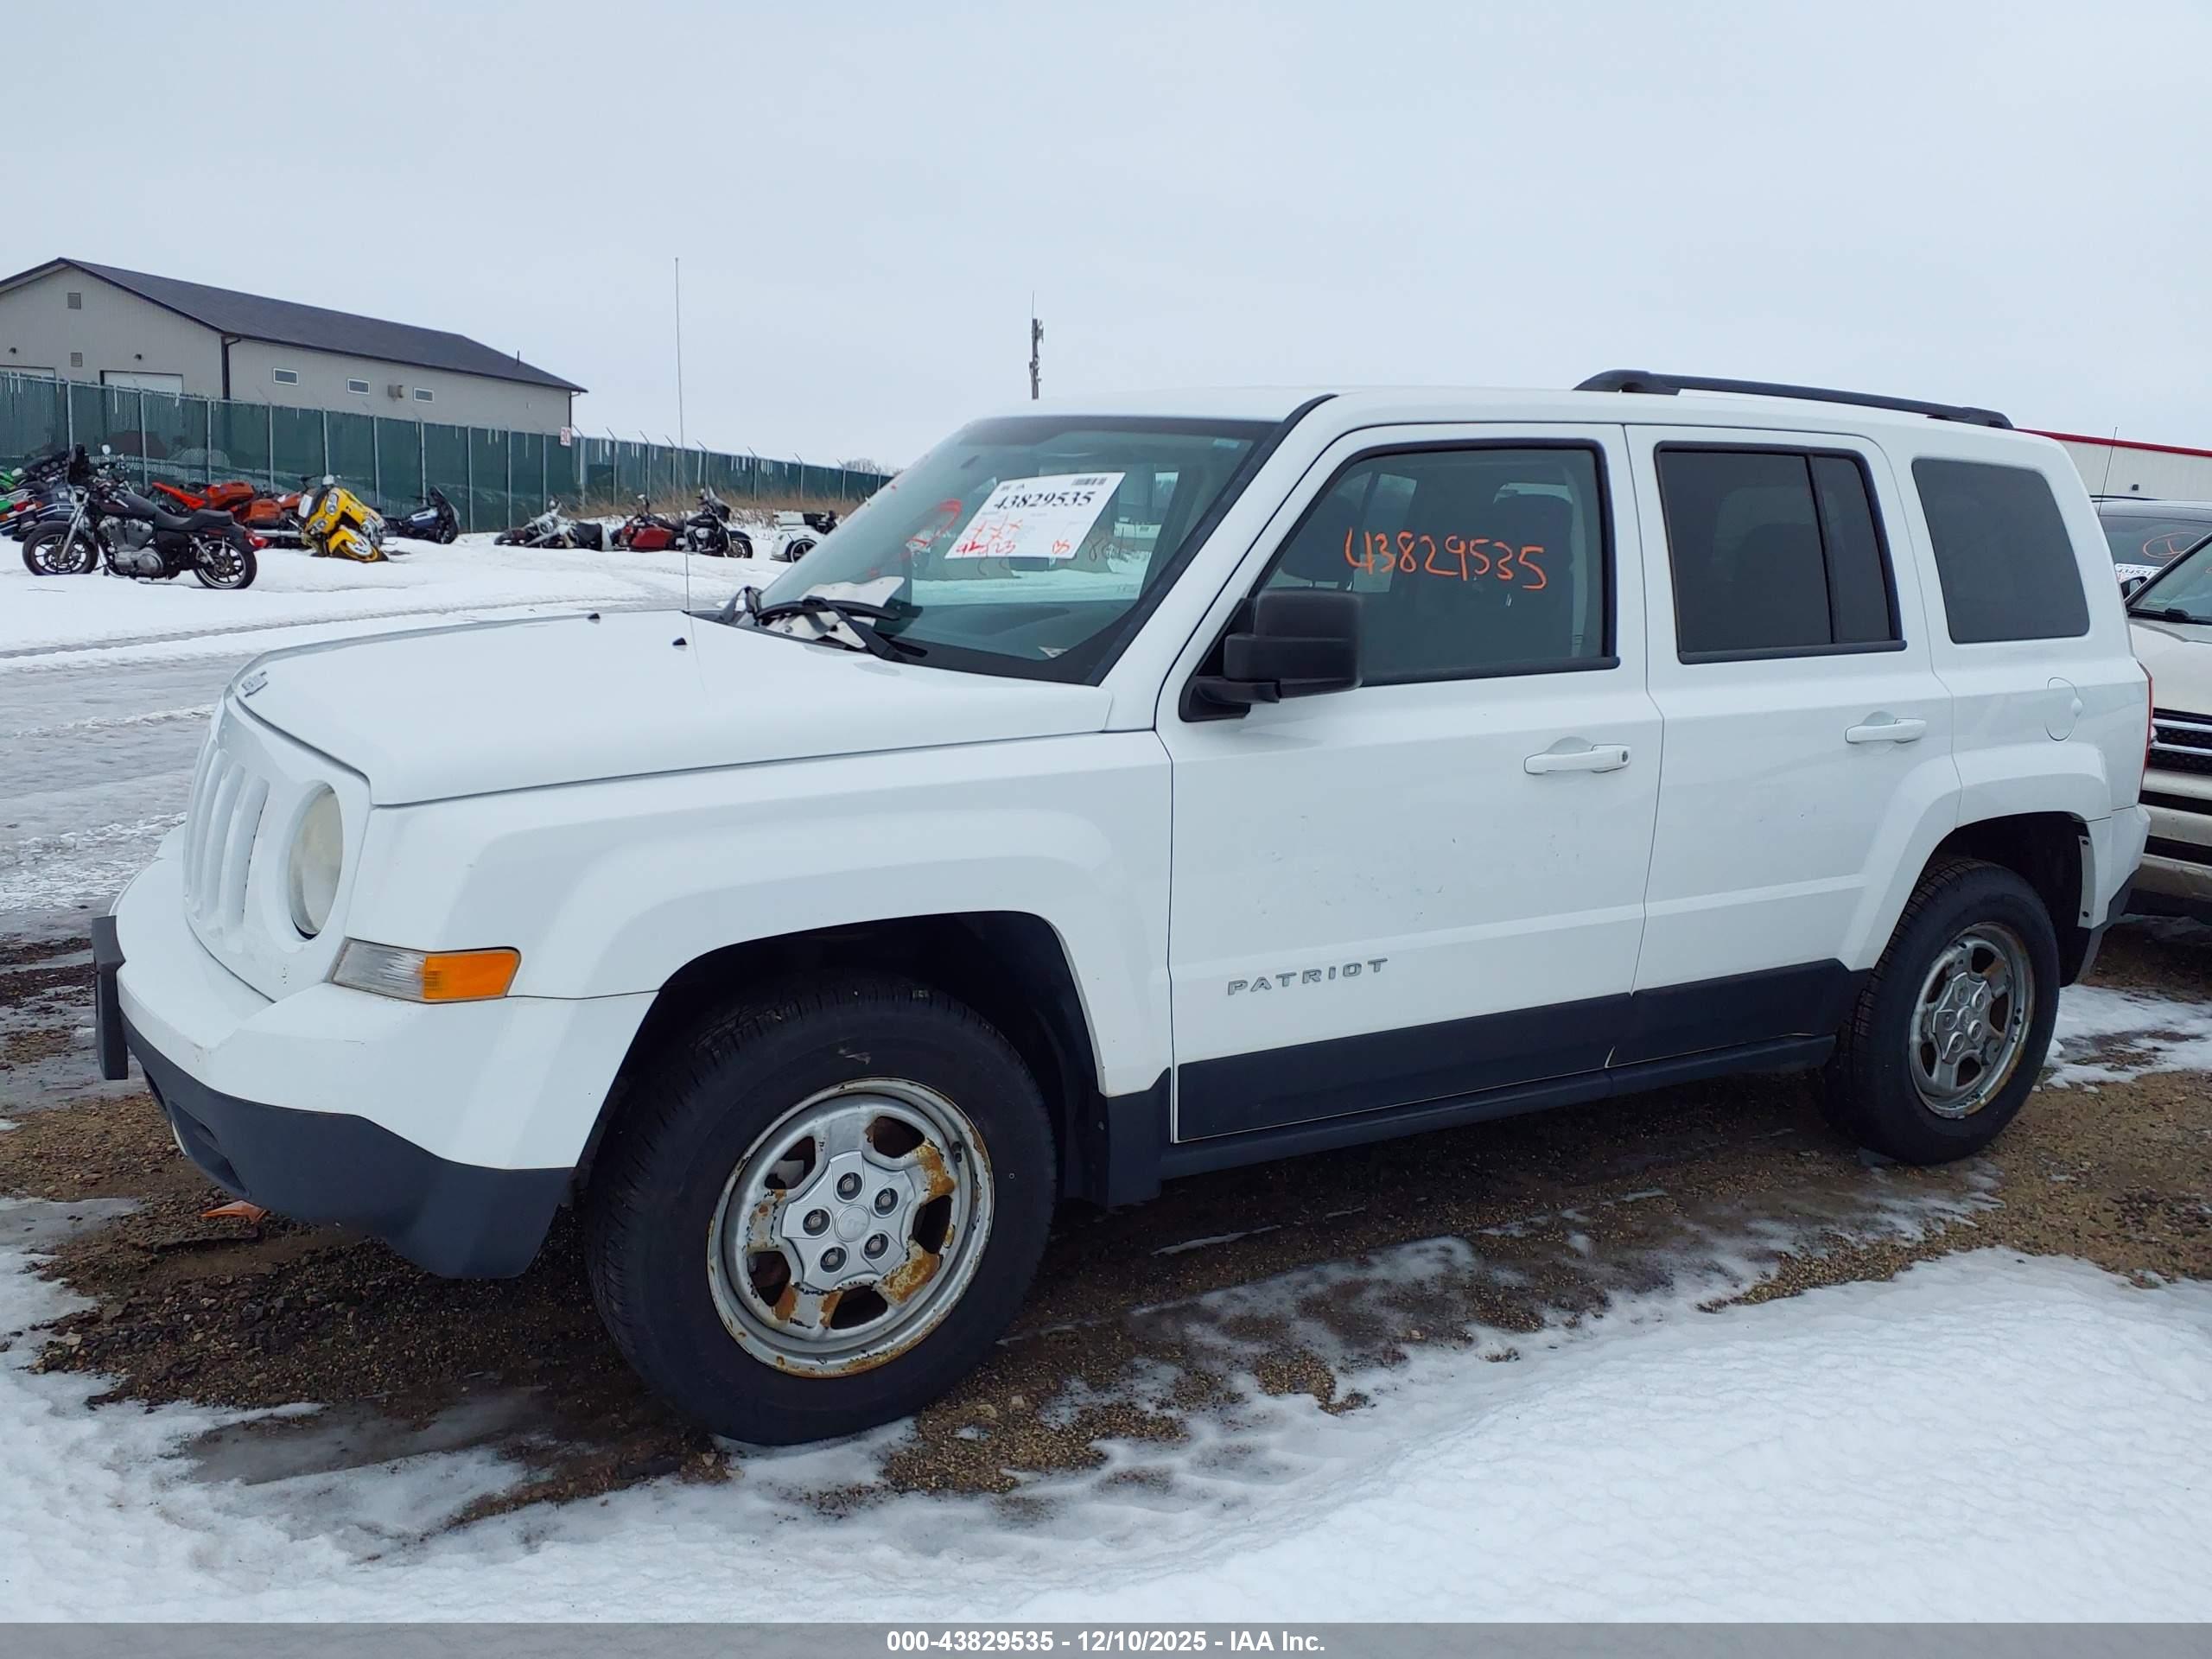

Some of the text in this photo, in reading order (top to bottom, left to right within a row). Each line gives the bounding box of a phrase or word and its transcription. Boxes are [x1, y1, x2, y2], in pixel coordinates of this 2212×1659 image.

[994, 490, 1096, 510] 43829535
[1344, 526, 1548, 590] 43829535
[1227, 957, 1389, 995] PATRIOT
